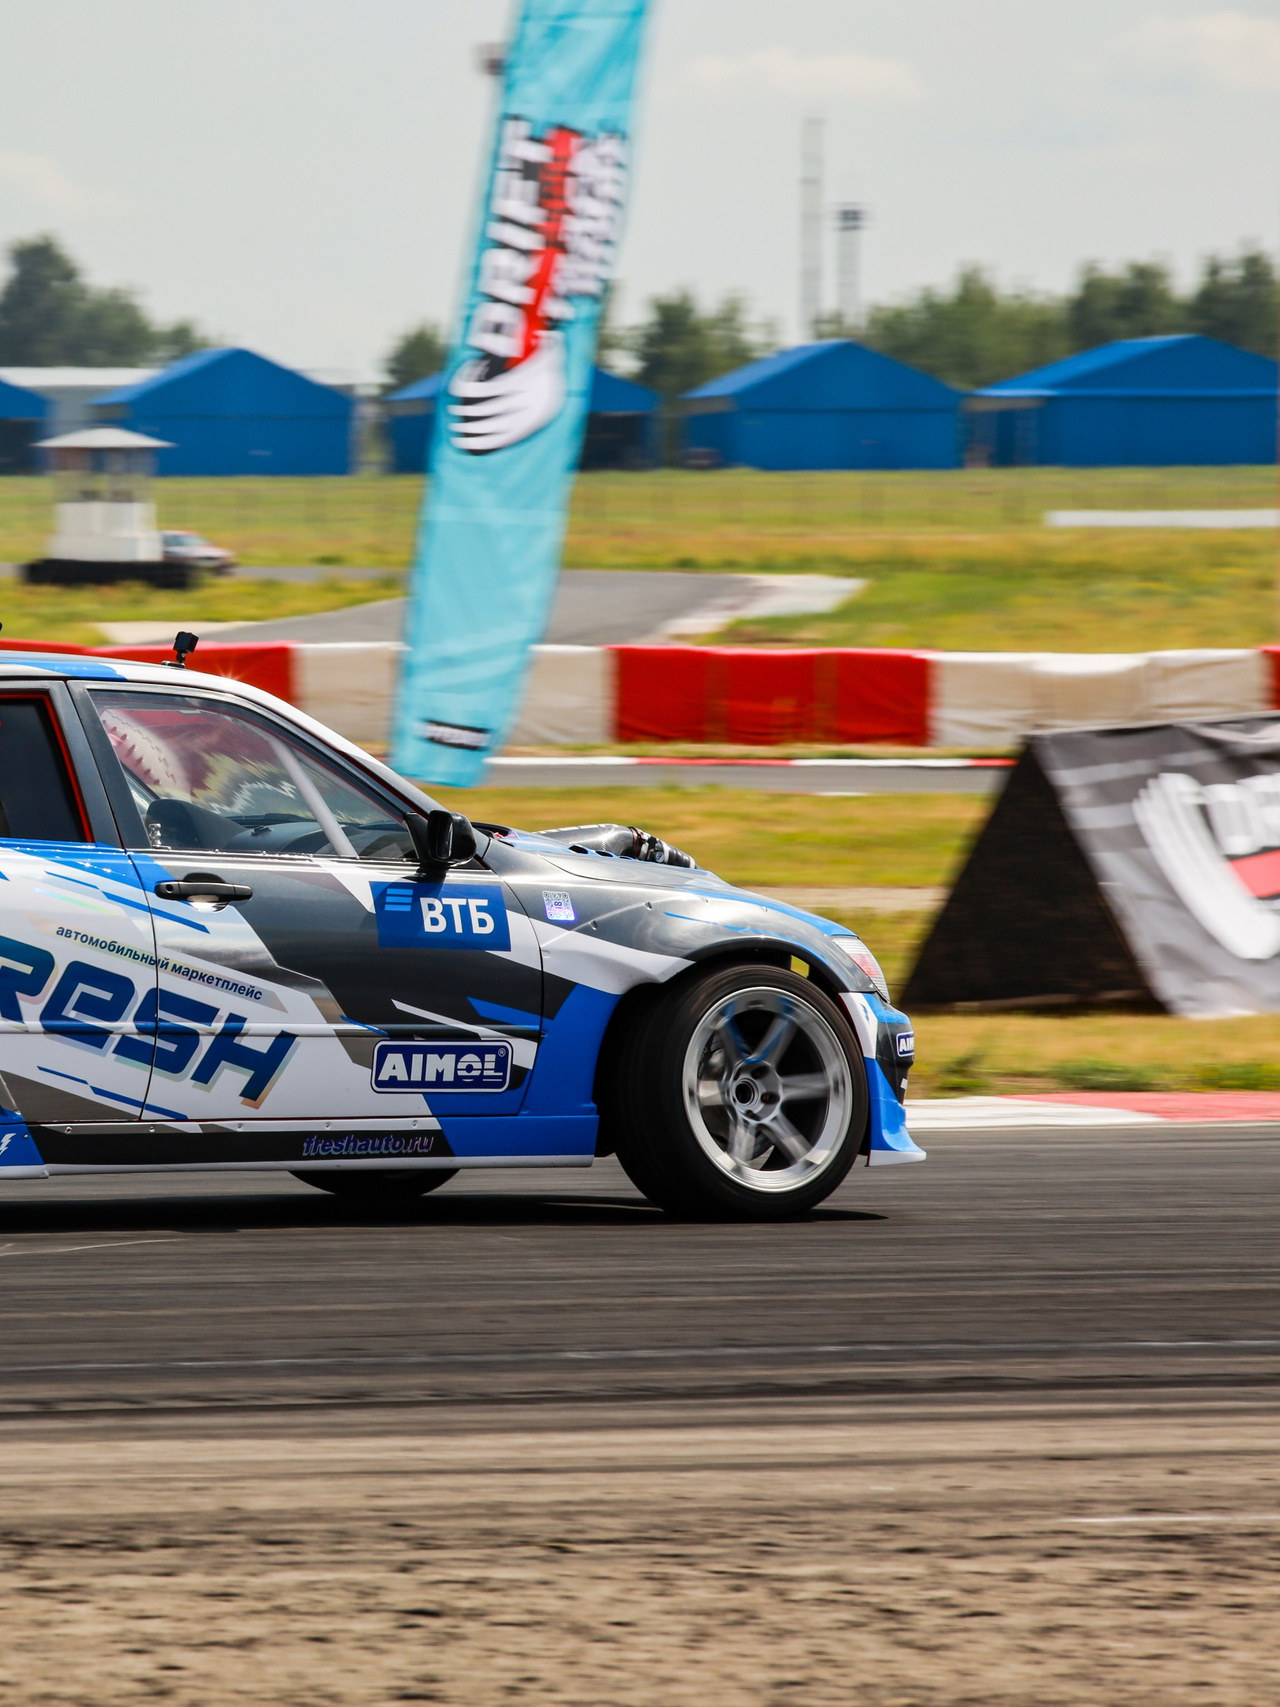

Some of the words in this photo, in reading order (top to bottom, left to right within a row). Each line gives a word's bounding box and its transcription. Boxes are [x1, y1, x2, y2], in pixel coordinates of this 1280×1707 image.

[465, 117, 554, 360] DRIFT
[419, 896, 495, 935] ВТБ
[55, 925, 171, 971] автомобильный
[170, 962, 264, 1001] маркетплейс
[302, 1133, 435, 1157] freshauto.ru
